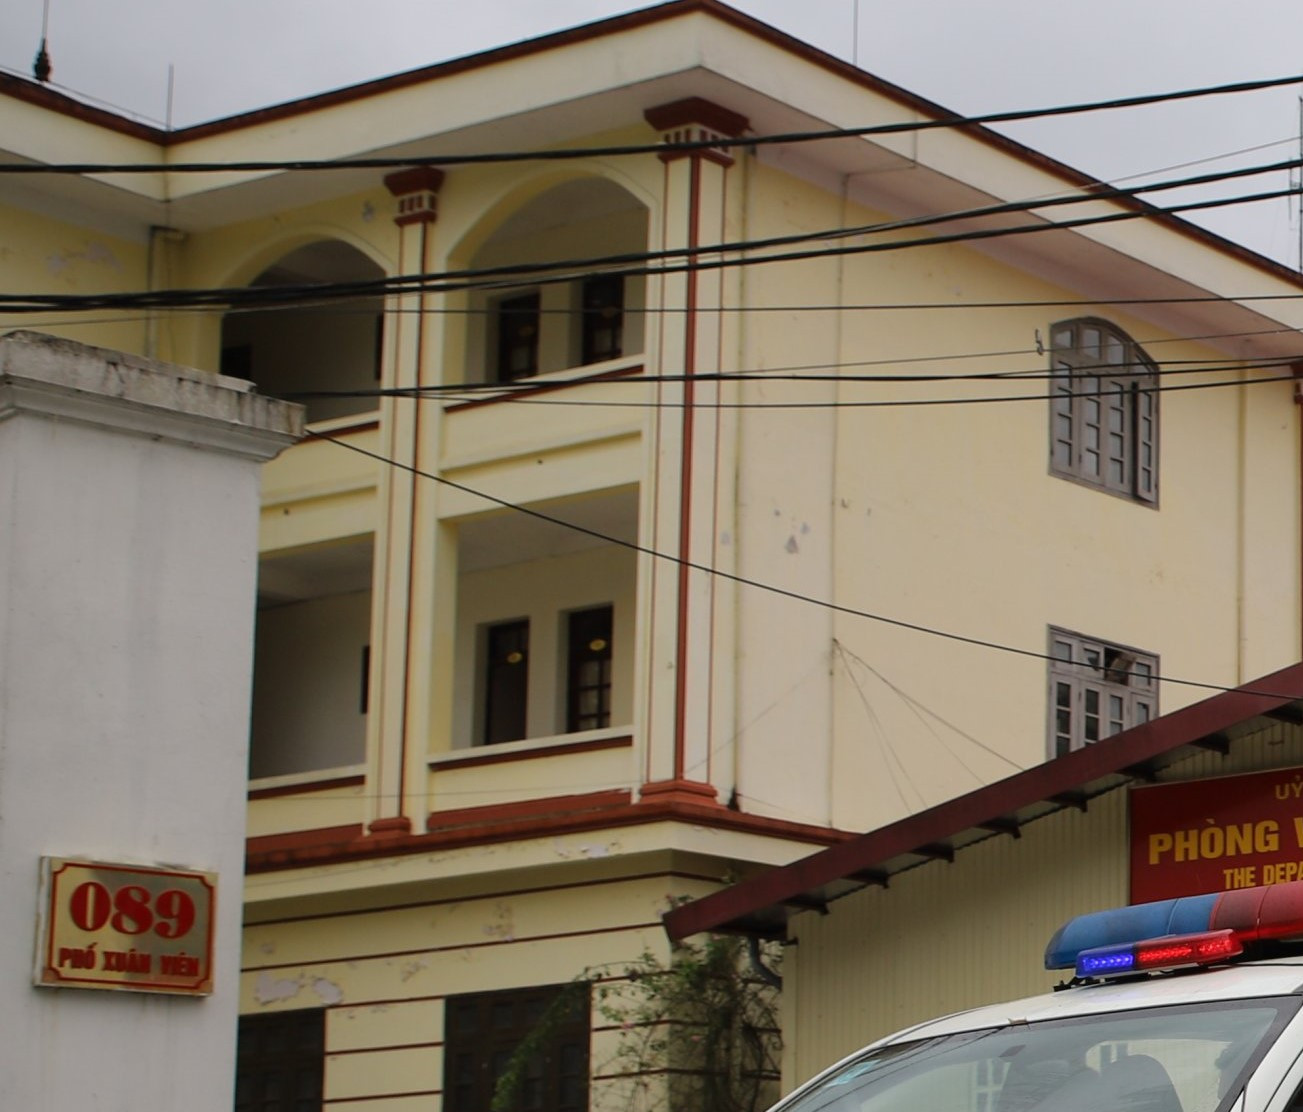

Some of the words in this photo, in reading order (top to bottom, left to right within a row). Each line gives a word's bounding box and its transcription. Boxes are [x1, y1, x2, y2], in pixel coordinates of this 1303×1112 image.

[1274, 775, 1303, 800] UỶ
[1148, 817, 1280, 865] PHÒNG
[1223, 865, 1256, 890] THE
[69, 881, 196, 939] 089
[58, 942, 98, 969] PHỐ
[102, 948, 152, 975] XUÂN
